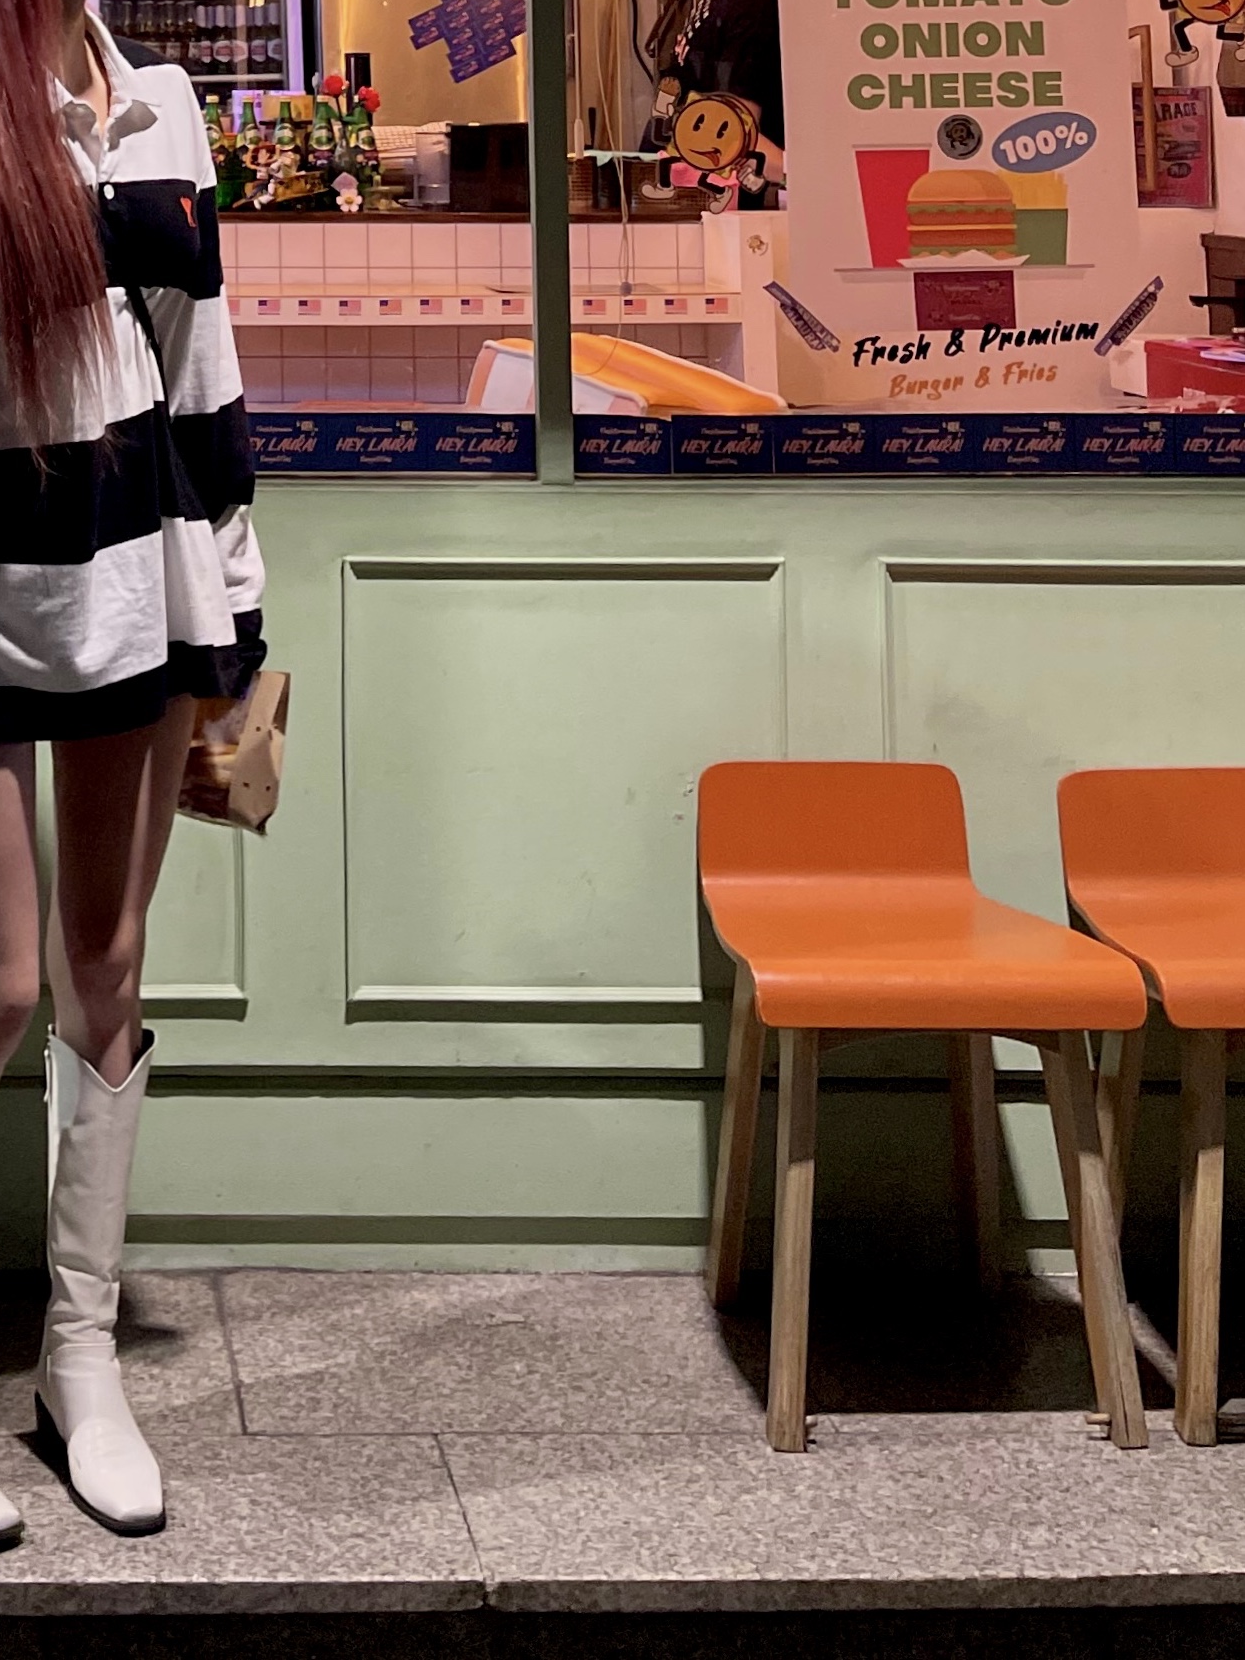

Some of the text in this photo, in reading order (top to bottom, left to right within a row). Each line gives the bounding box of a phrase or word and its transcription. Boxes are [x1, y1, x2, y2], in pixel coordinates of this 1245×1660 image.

[859, 21, 1045, 59] ONION
[846, 71, 1063, 110] CHEESE
[999, 121, 1089, 164] 100%
[852, 320, 1100, 367] Fresh & Premium
[889, 361, 1058, 401] Burger & Fries
